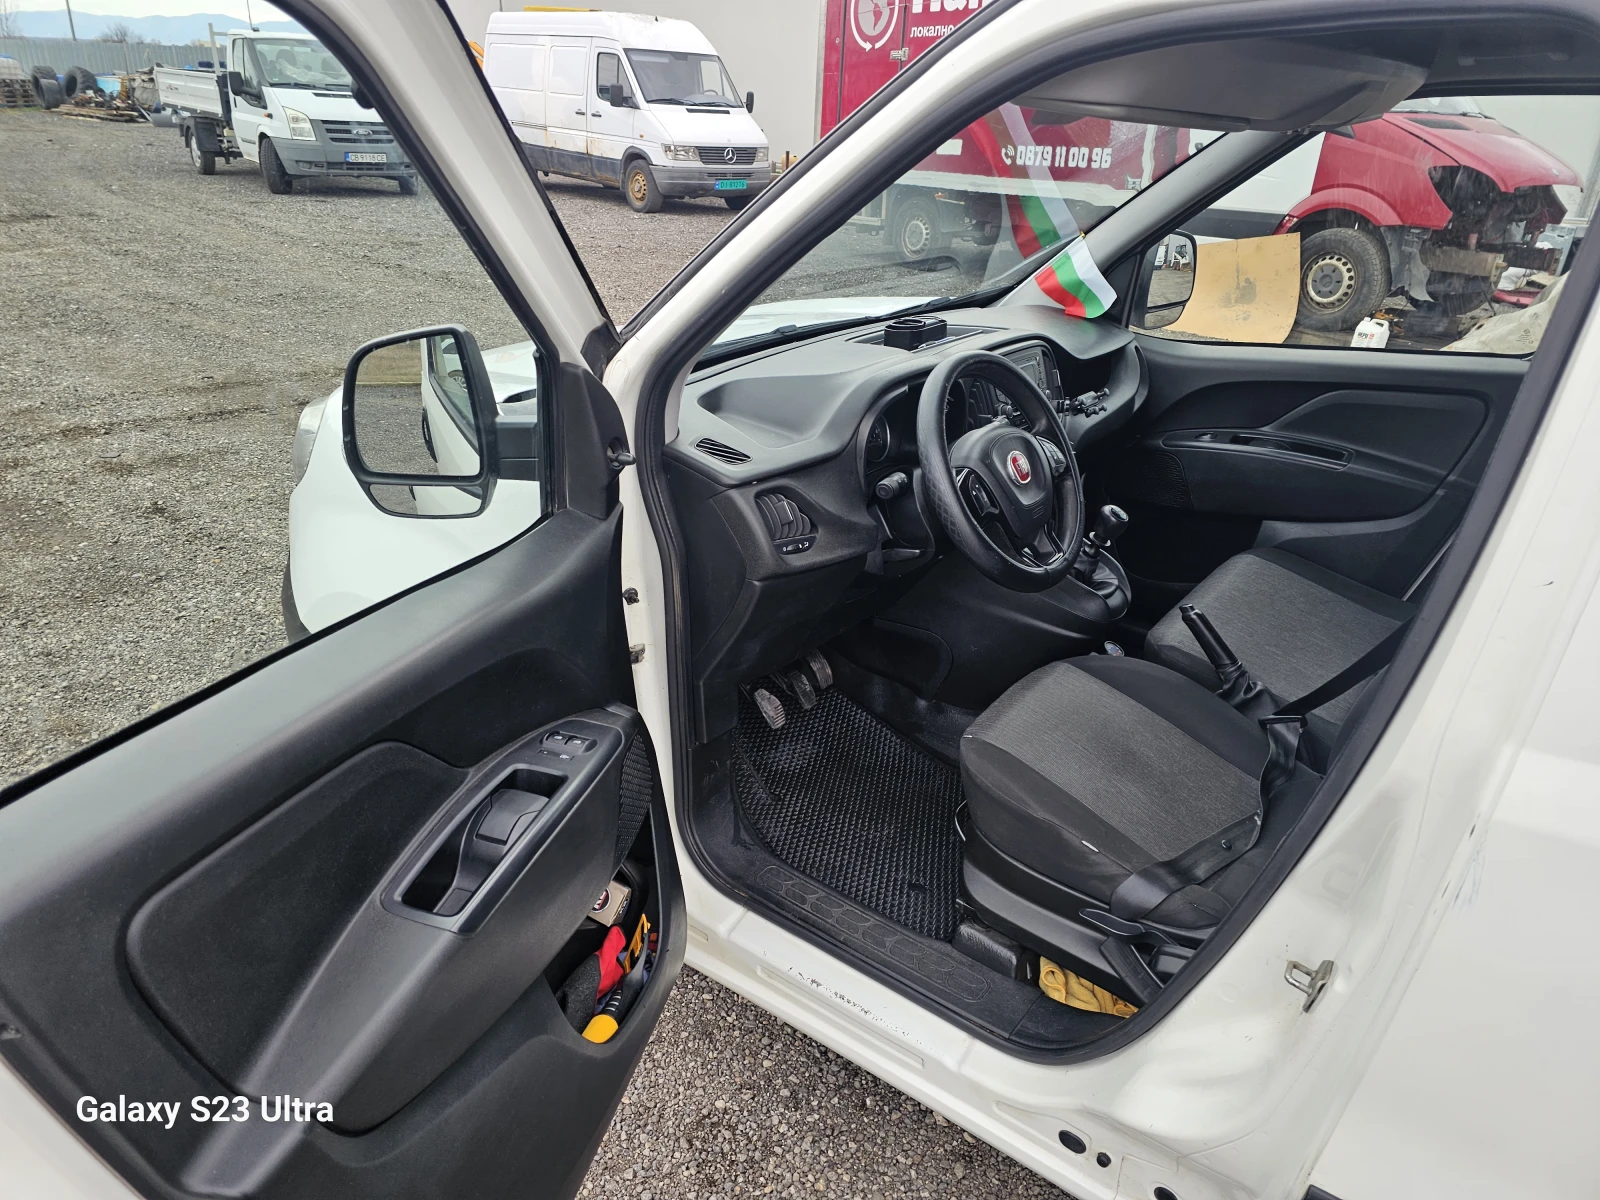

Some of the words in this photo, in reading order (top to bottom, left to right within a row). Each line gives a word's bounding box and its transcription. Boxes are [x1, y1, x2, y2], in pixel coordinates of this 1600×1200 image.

[1016, 145, 1053, 167] 0879
[1055, 146, 1067, 168] 11
[1068, 147, 1090, 168] 00
[1091, 147, 1113, 169] 96
